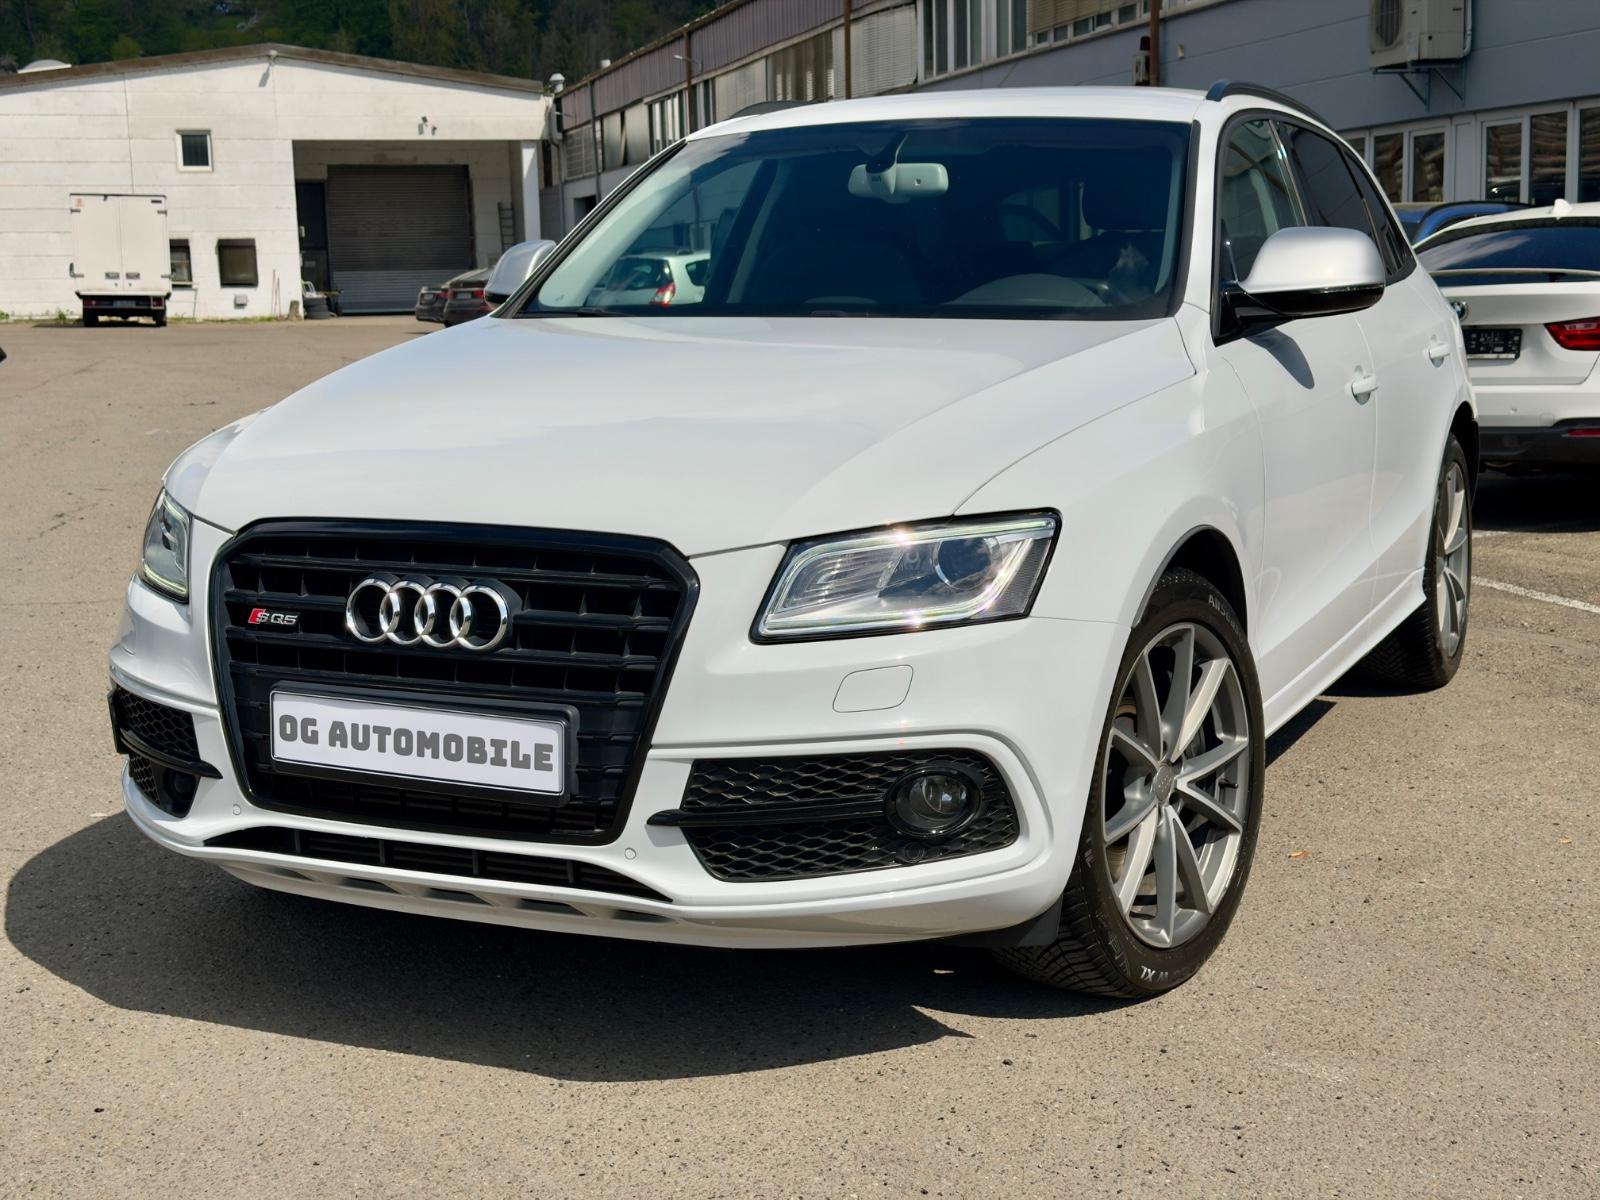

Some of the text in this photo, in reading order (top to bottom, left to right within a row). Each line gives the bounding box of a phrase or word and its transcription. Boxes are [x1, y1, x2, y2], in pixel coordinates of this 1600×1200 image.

[255, 611, 298, 625] SQ5
[279, 714, 554, 772] OG AUTOMOBILE
